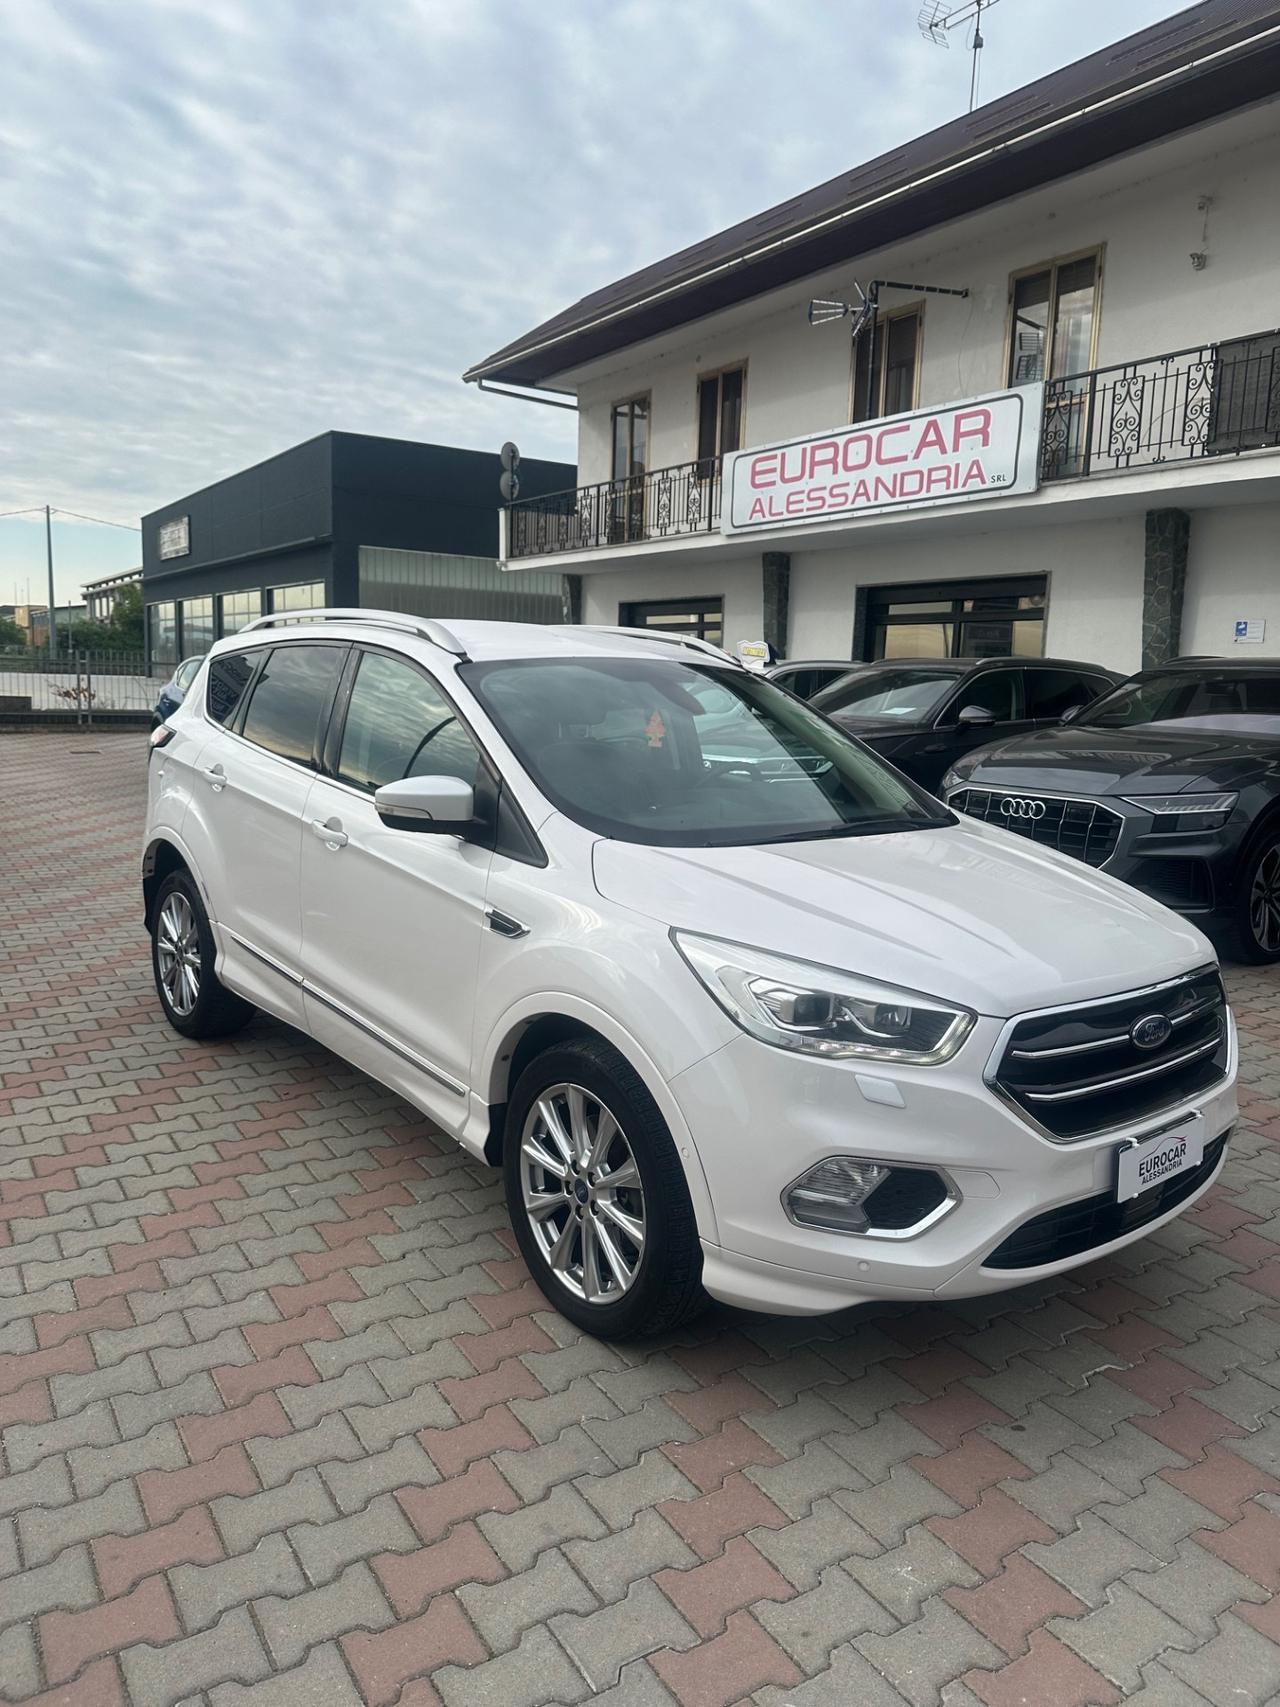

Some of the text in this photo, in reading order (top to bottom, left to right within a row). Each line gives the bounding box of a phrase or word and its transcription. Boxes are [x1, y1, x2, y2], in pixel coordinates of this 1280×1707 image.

[751, 408, 991, 489] EUROCAR
[749, 459, 1007, 520] ALESSANDRIA SRL
[1139, 1143, 1187, 1177] EUROCAR
[1141, 1159, 1182, 1185] ALESSANDRIA
